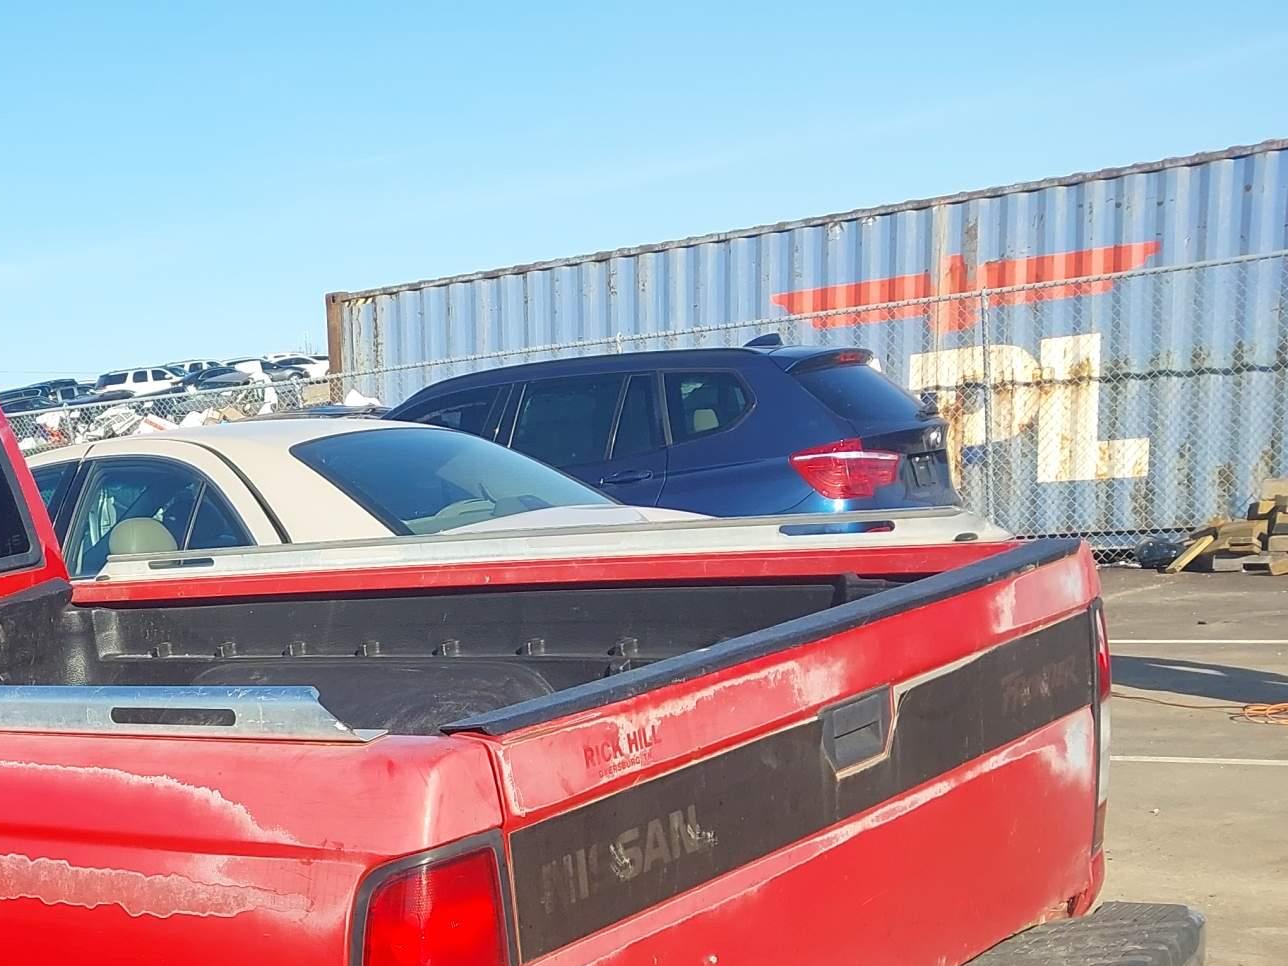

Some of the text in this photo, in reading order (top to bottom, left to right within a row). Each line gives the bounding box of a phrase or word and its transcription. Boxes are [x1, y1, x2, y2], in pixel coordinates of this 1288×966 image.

[870, 332, 1150, 490] PL
[584, 725, 662, 768] RICK HILL
